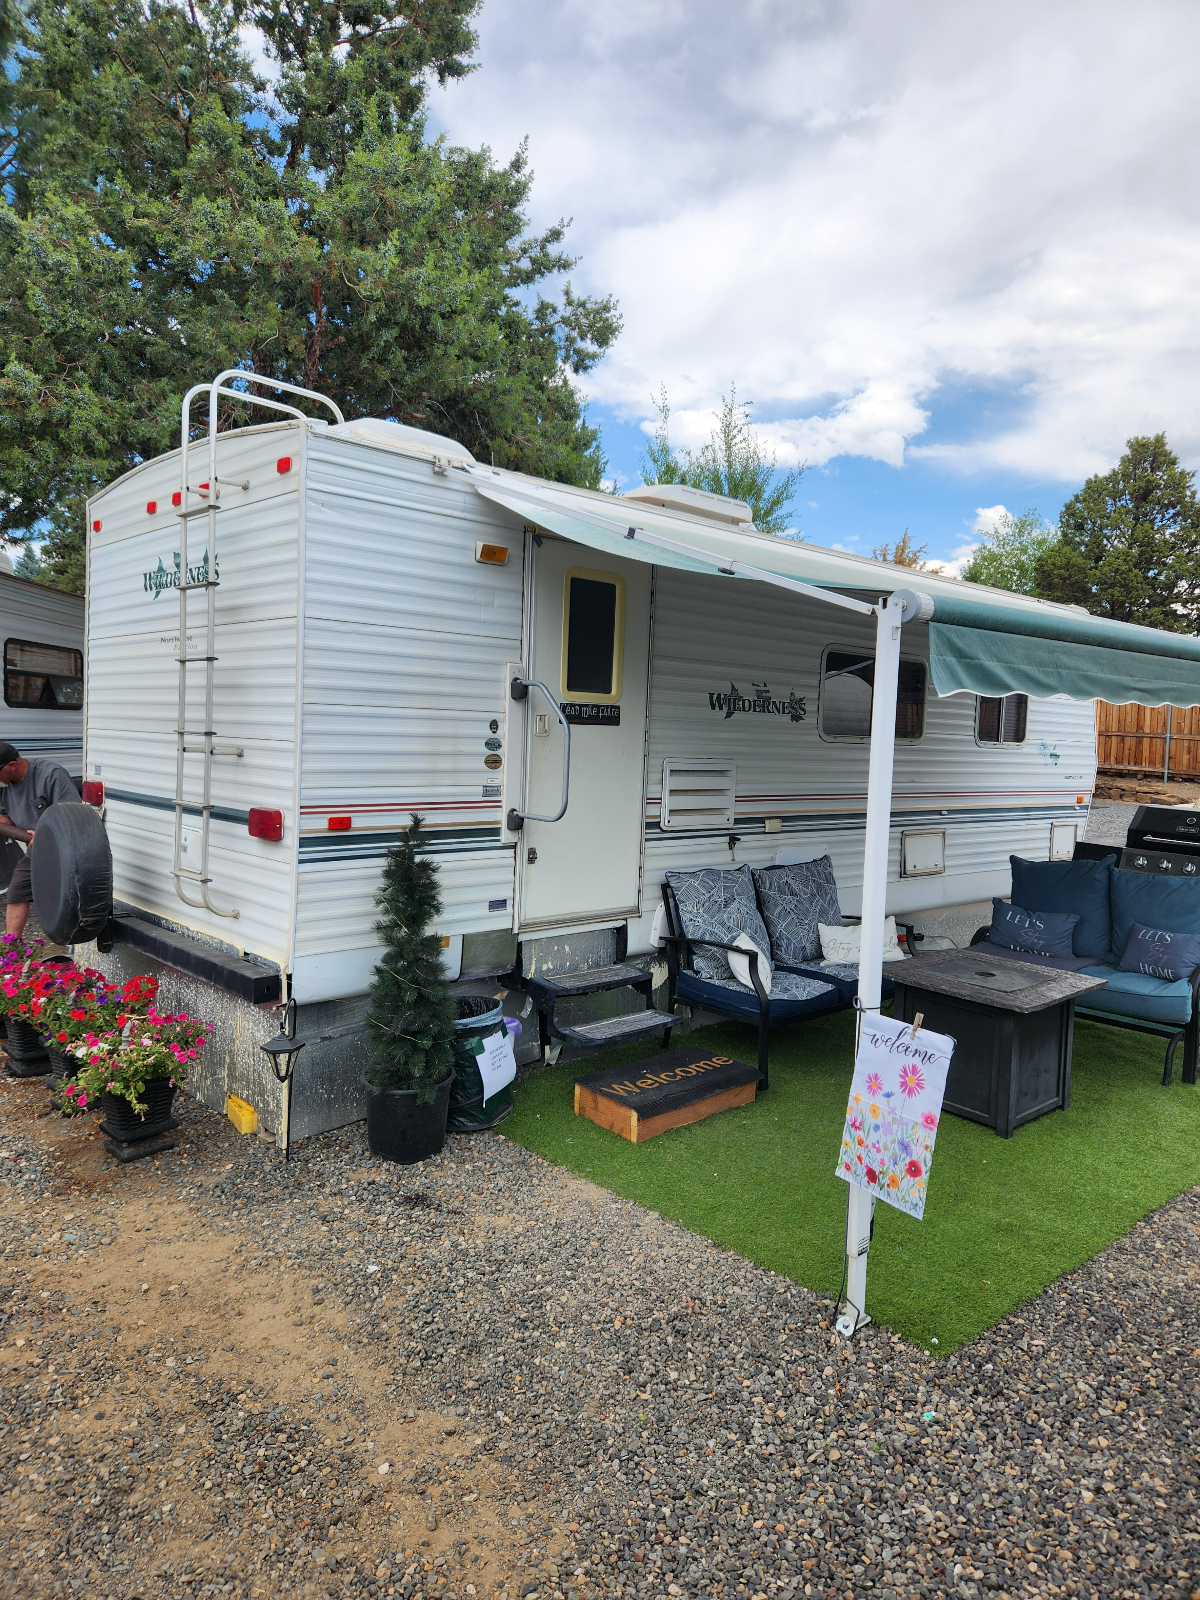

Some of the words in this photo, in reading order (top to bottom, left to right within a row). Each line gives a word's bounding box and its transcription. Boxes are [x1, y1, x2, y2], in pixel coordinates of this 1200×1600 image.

[143, 562, 220, 592] WILDENESS
[160, 635, 193, 644] Northst
[708, 692, 807, 716] WILDERNESS
[1006, 910, 1045, 930] LET'S
[1138, 929, 1174, 944] LET'S
[1140, 962, 1176, 980] HOME
[863, 1026, 951, 1066] welcome
[601, 1055, 734, 1097] Welcome
